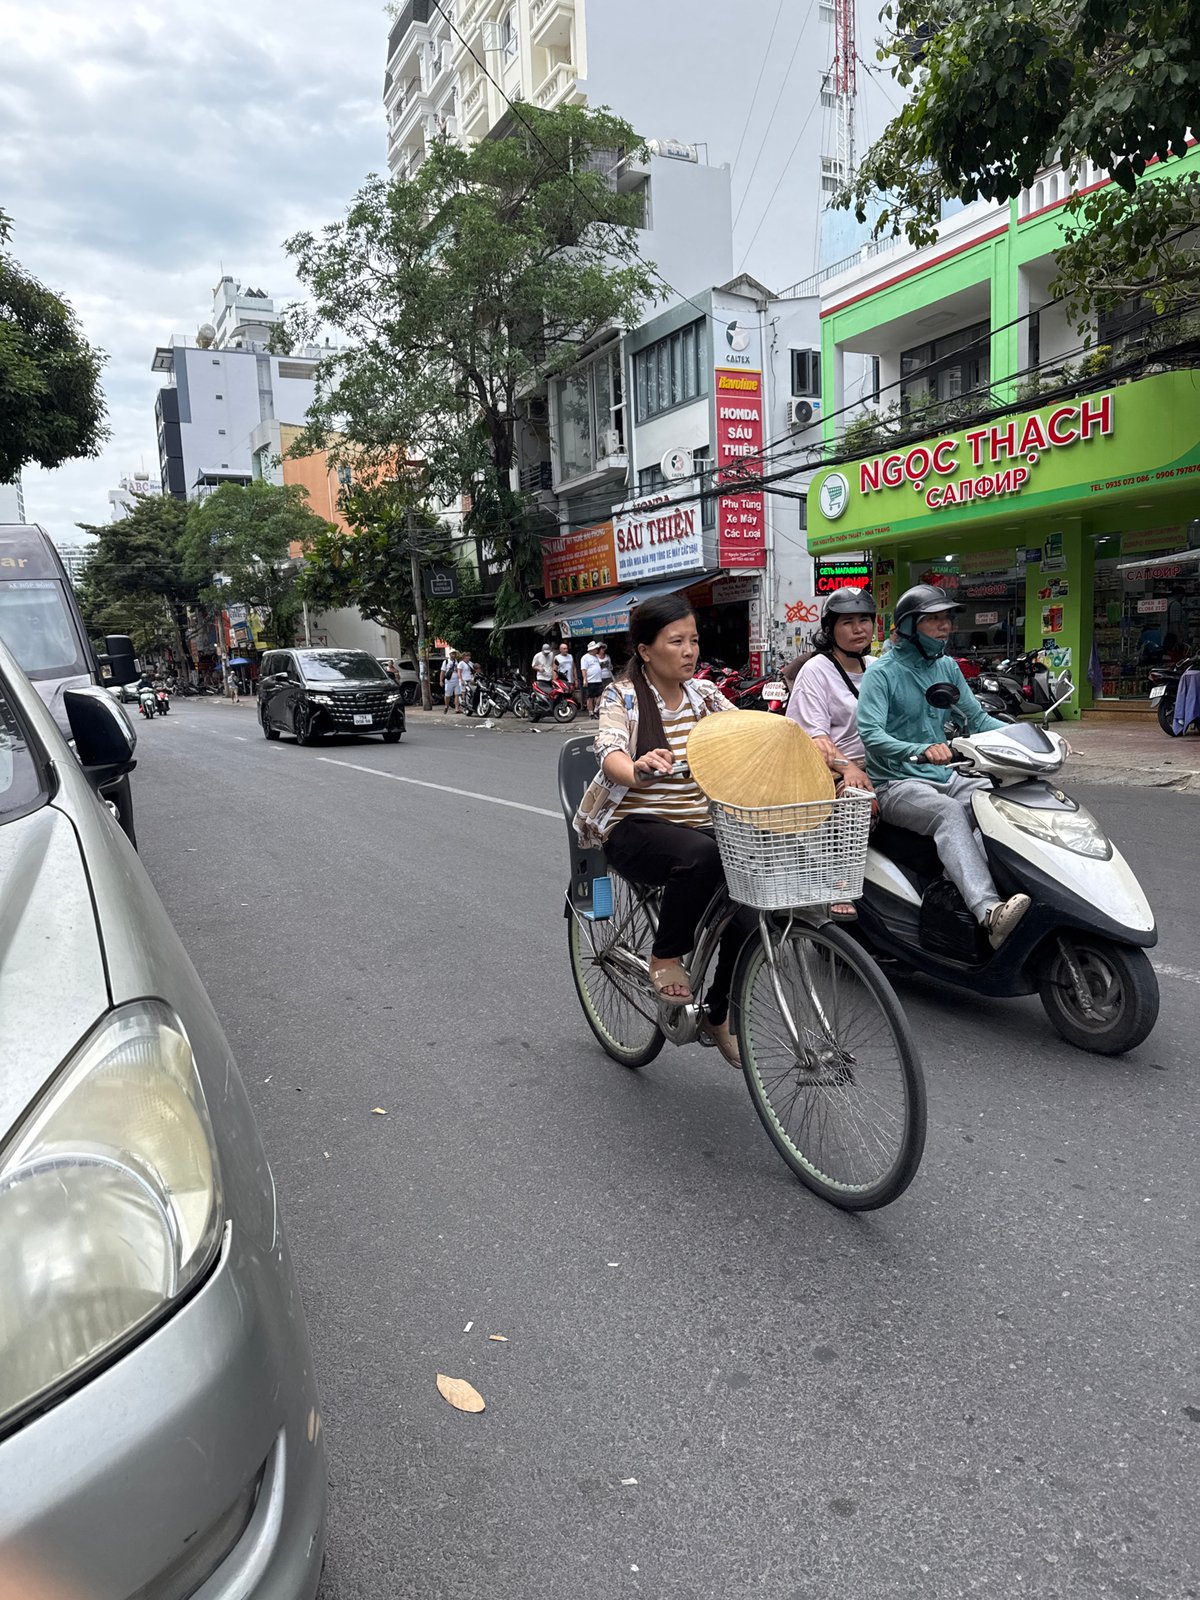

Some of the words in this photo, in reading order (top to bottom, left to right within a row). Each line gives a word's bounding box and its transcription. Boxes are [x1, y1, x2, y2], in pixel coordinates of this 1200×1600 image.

[726, 354, 750, 364] CALTEX
[719, 376, 758, 391] Havoline
[720, 407, 759, 421] HONDA
[727, 424, 753, 440] SÁU
[859, 439, 960, 495] NGỌC
[966, 393, 1117, 465] THẠCH
[129, 482, 149, 492] ABC
[925, 466, 1032, 510] САПФИР
[1090, 484, 1104, 492] TEL:
[1105, 480, 1121, 489] 0935
[1123, 478, 1135, 486] 073
[1136, 475, 1149, 483] 086
[1155, 471, 1174, 480] 0906
[722, 499, 739, 511] Phụ
[741, 500, 761, 511] Tùng
[727, 514, 738, 524] Xe
[740, 514, 757, 526] Máy
[617, 521, 643, 554] SÁU
[647, 507, 696, 546] THIỆN
[724, 529, 741, 538] Các
[744, 529, 761, 540] Loại
[1127, 566, 1181, 580] САПФИР
[817, 576, 870, 591] САПФИР
[966, 583, 1008, 598] САПФИР
